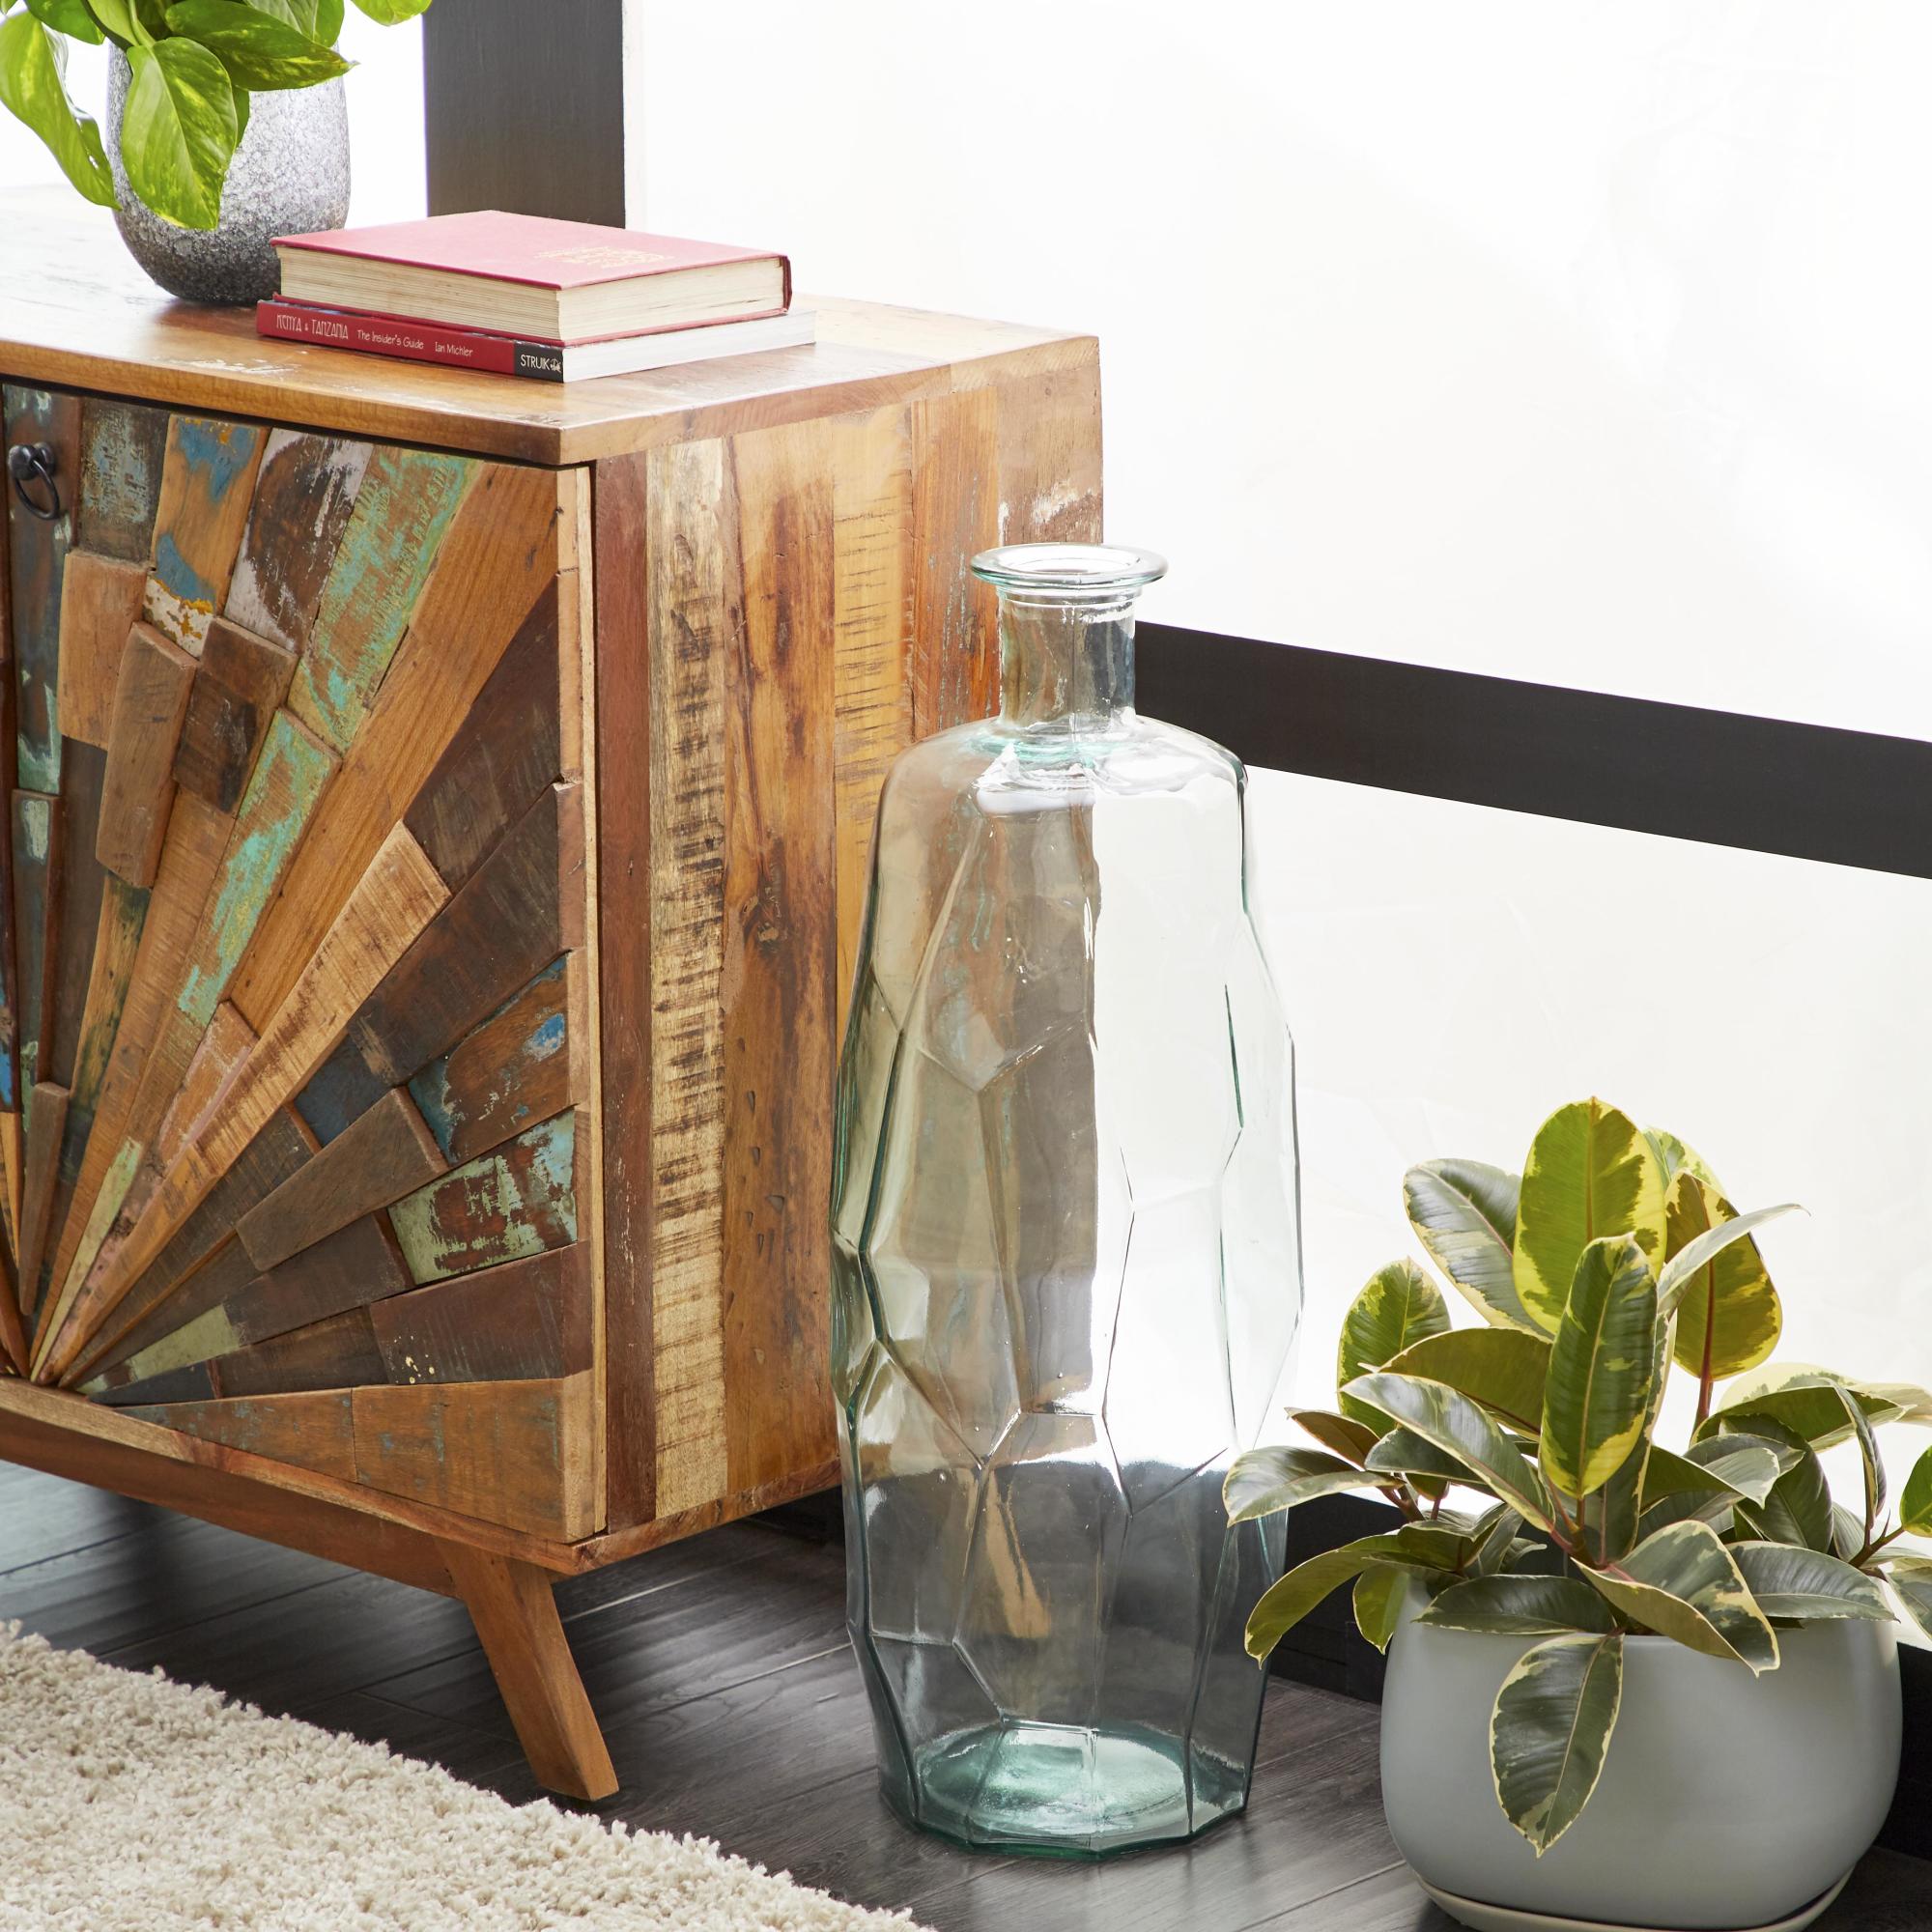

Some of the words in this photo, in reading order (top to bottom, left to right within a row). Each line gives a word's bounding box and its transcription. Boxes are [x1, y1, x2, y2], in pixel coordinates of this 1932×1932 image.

[356, 329, 371, 341] The
[372, 331, 402, 346] Insider's
[402, 336, 424, 350] Guide
[435, 341, 445, 354] Ian
[446, 344, 473, 356] Michler
[520, 354, 551, 371] STRUIK
